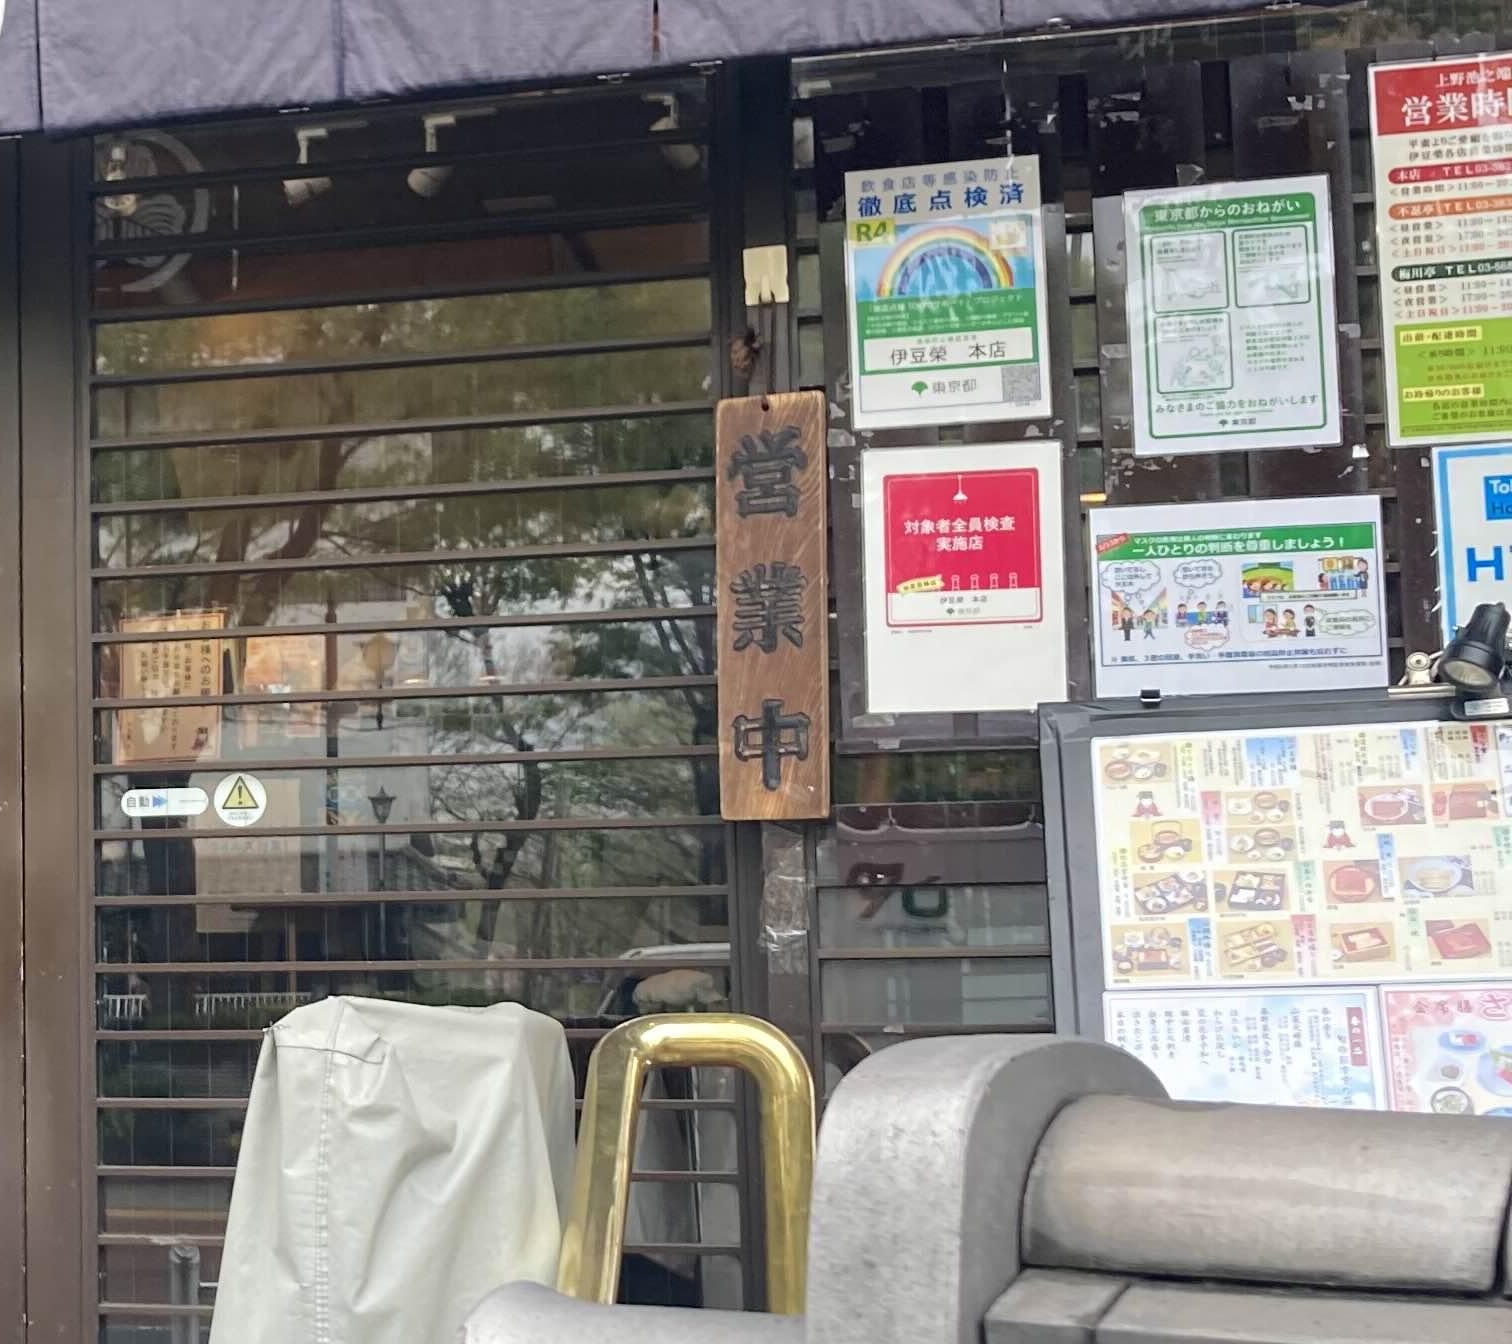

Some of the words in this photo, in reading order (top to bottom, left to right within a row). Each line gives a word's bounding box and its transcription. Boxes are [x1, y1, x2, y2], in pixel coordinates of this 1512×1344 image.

[1401, 88, 1512, 127] 営業時
[858, 183, 1024, 218] 徹底点検済
[1155, 199, 1300, 223] 東京都からのおねがい
[855, 222, 888, 243] R4
[890, 346, 947, 366] 伊豆榮
[968, 341, 1006, 359] 本店
[1488, 478, 1512, 495] To
[904, 516, 1016, 535] 対象者全員検査
[936, 536, 984, 552] 実施店
[1467, 544, 1512, 582] H
[726, 425, 811, 791] 営業中
